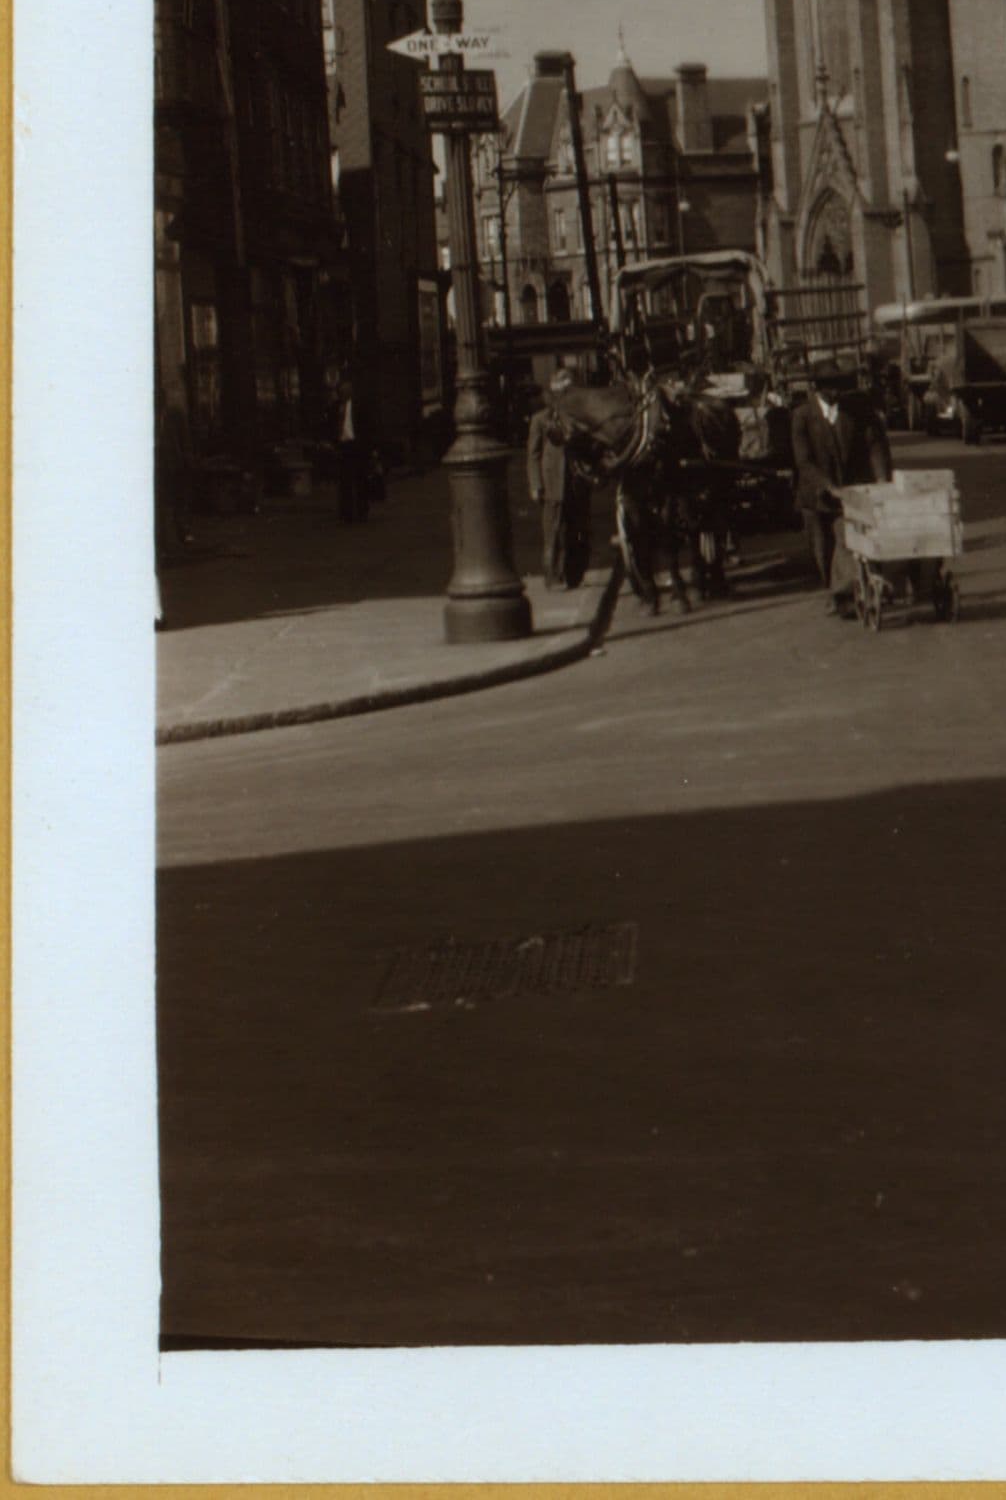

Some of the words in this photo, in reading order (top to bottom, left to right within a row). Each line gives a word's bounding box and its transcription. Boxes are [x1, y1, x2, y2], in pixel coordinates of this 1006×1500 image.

[407, 39, 437, 53] ONE
[456, 37, 489, 49] WAY
[463, 75, 495, 93] SEET
[424, 95, 455, 113] DRIVE
